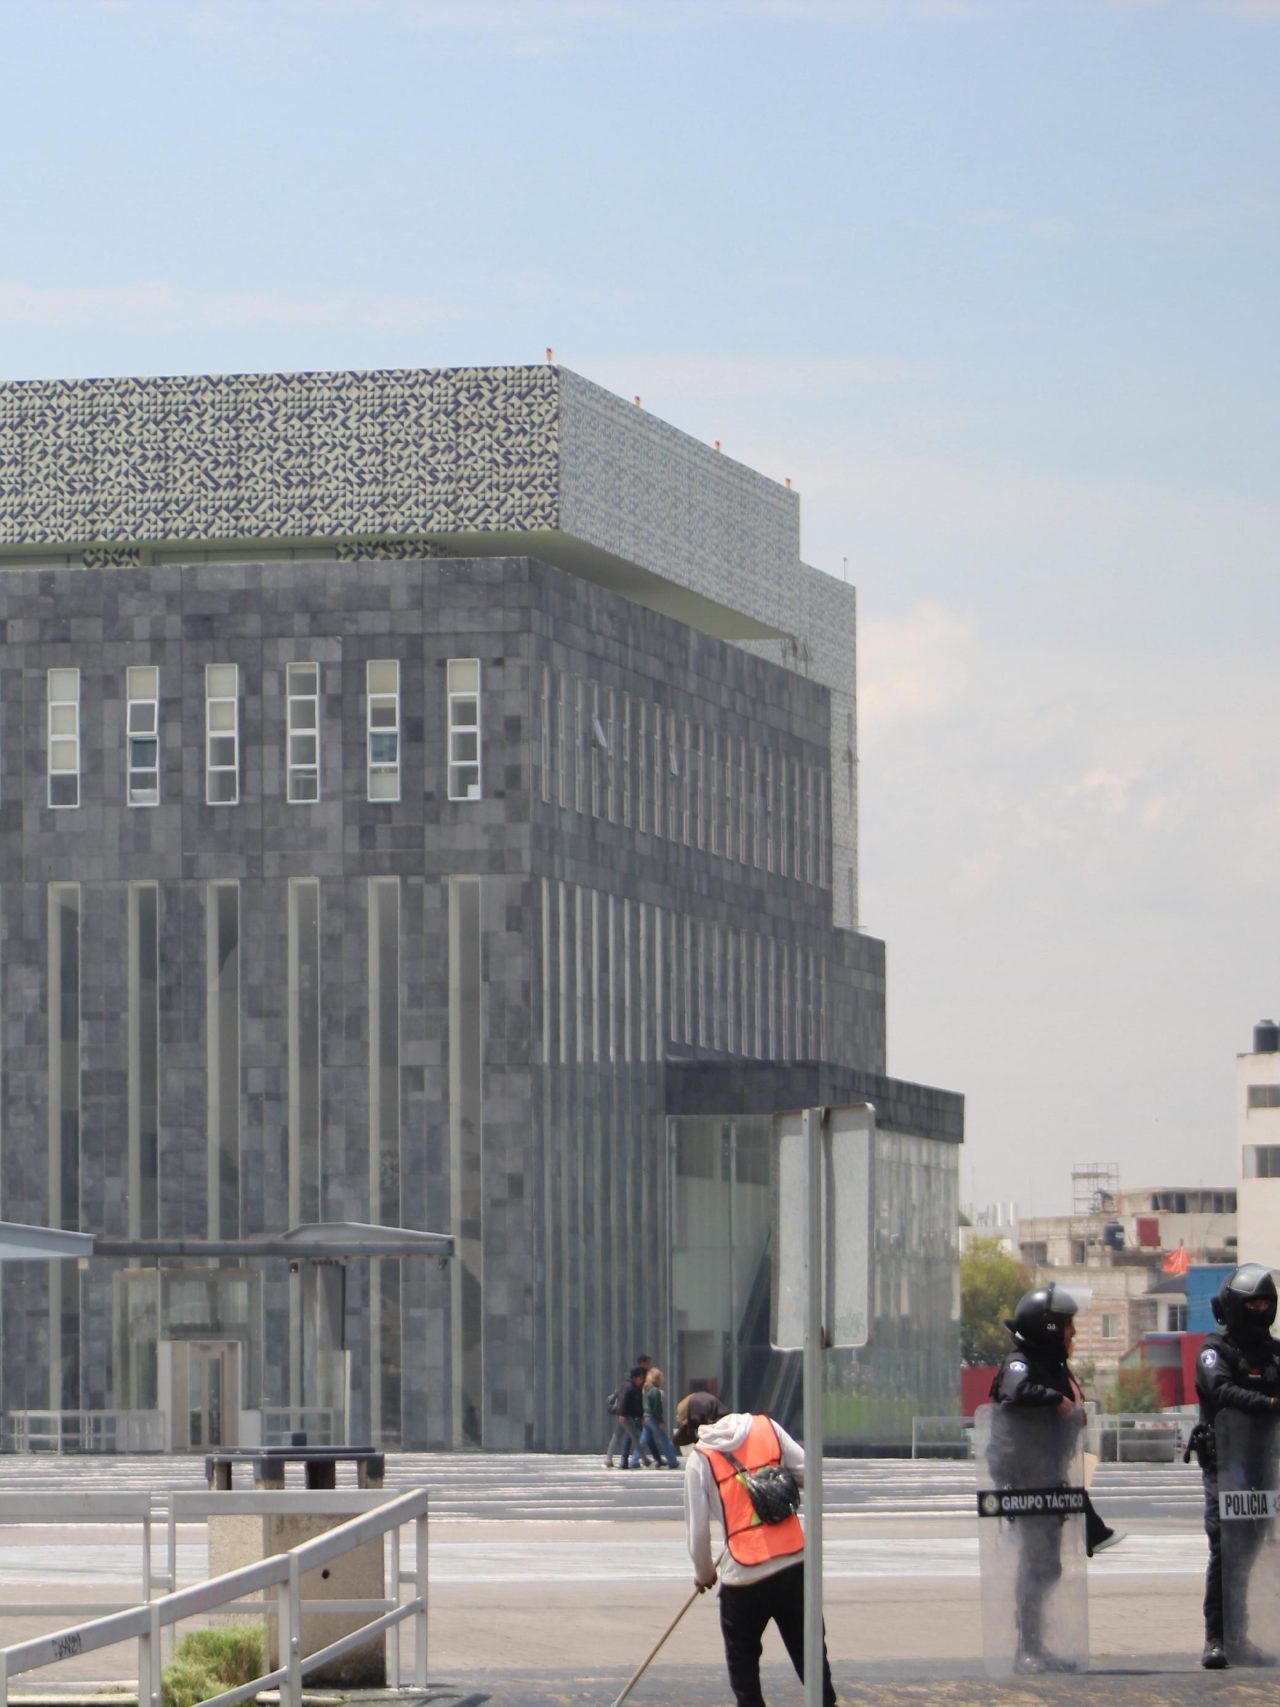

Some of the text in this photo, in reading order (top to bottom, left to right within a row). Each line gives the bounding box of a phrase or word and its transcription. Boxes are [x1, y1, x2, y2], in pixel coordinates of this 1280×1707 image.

[1001, 1492, 1083, 1510] GRUPO TÁCTICO
[1224, 1493, 1268, 1516] POLICIA
